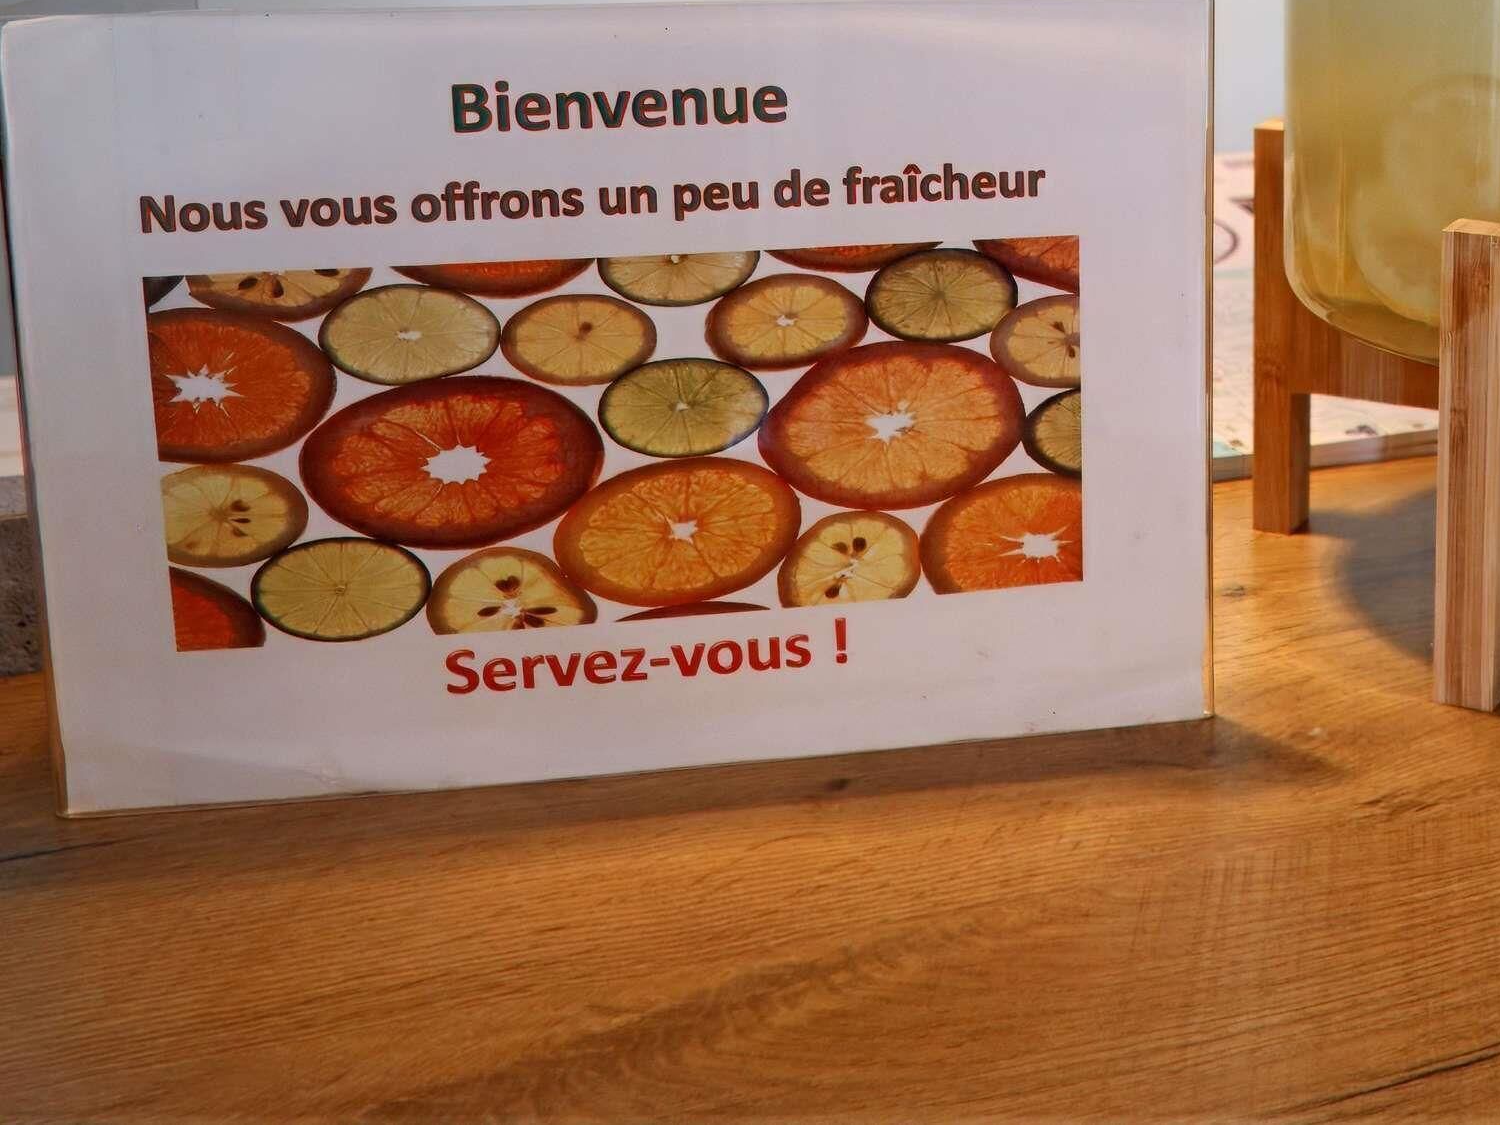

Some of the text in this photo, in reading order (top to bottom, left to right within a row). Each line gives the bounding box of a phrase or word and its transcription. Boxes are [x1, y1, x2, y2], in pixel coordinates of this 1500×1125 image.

[450, 79, 789, 135] Bienvenue
[138, 161, 1047, 235] Nous vous offrons un peu de fraîcheur
[444, 616, 849, 696] Servez-vous !
